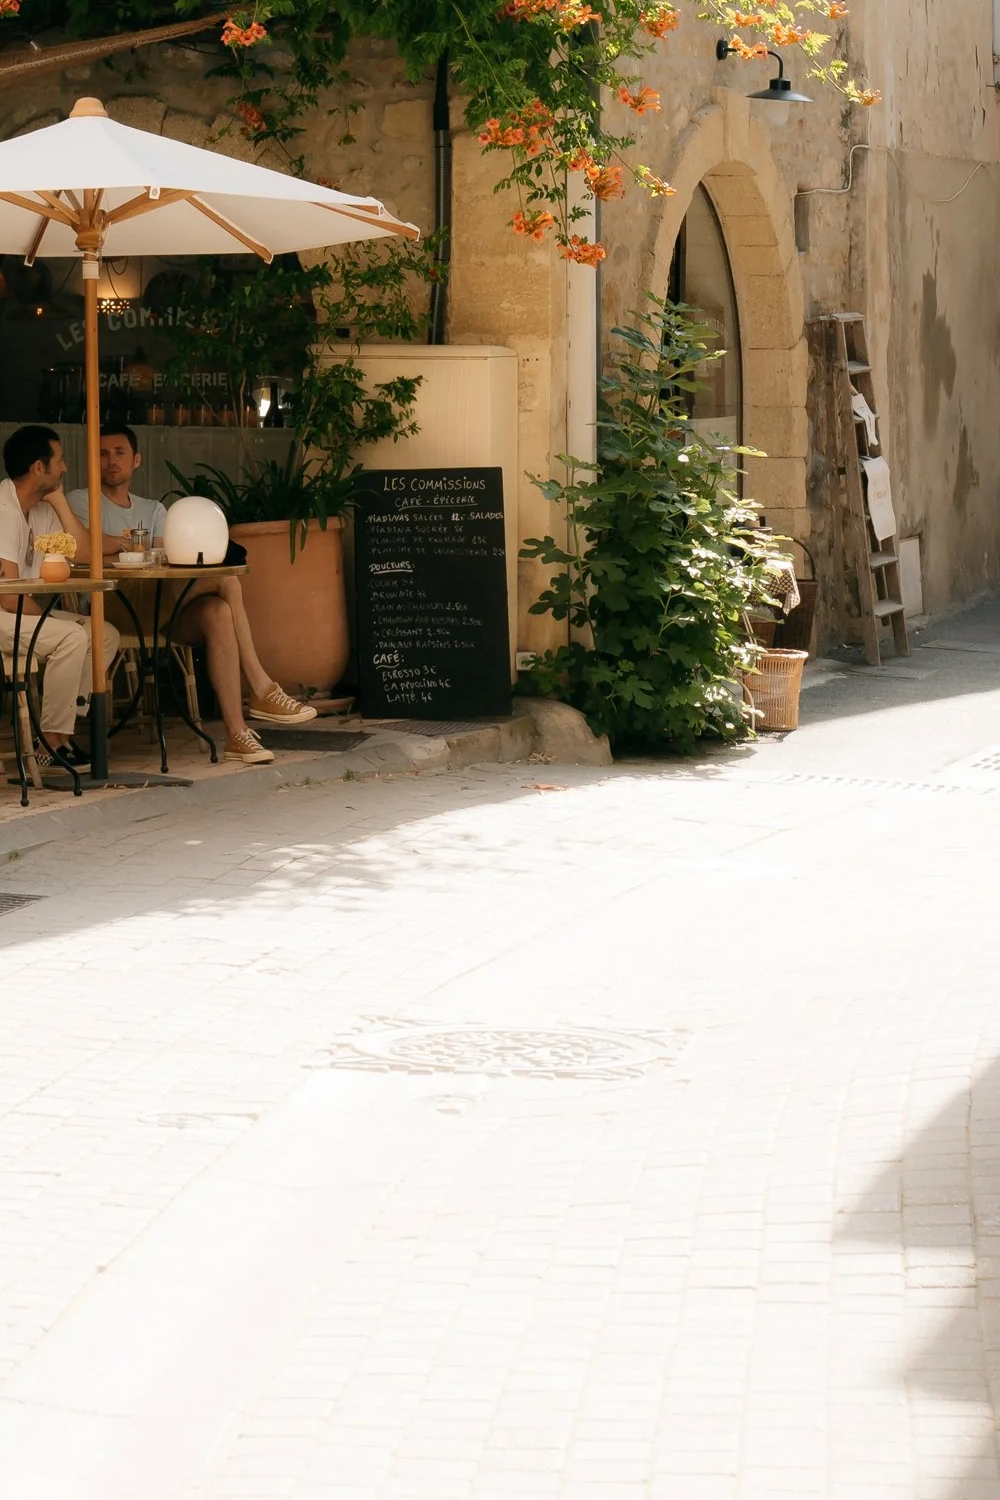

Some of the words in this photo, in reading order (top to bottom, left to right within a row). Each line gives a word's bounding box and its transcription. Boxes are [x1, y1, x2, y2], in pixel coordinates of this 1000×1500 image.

[384, 476, 405, 491] LES
[410, 476, 486, 491] COMMISSIONS
[395, 495, 422, 508] CAFÉ
